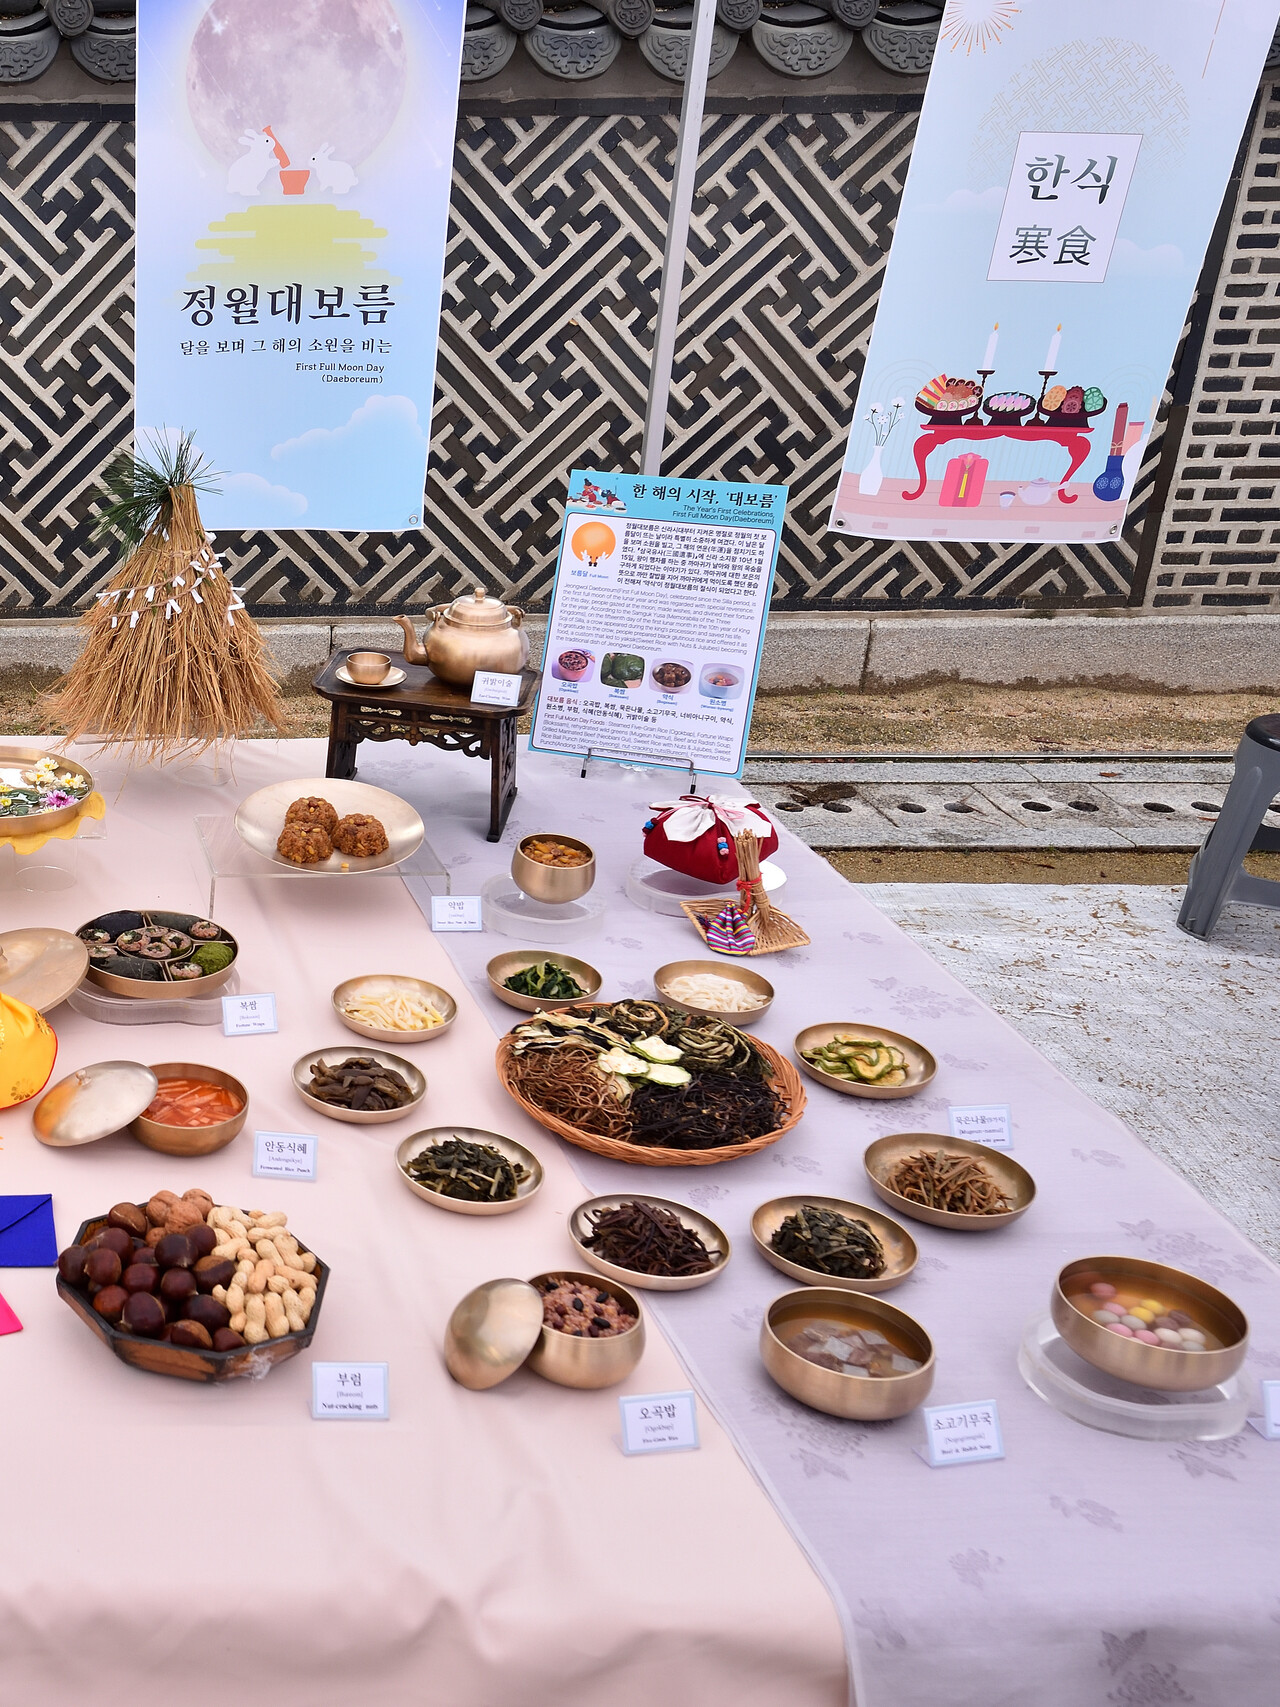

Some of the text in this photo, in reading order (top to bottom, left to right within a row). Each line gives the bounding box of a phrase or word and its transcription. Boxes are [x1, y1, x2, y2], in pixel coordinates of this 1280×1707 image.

[1025, 154, 1118, 204] 한식
[1009, 224, 1096, 266] 寒食
[181, 283, 395, 326] 정월대보름
[180, 338, 392, 356] 달을 보며 그 해의 소원을 비는
[296, 363, 384, 374] First Full Moon Day
[321, 375, 383, 384] (Daeboreum)
[633, 484, 647, 498] 한
[652, 486, 681, 502] 해의
[686, 488, 719, 504] 시작,
[719, 514, 774, 525] Day(Daeboreum)
[732, 508, 775, 519] Celebrations,
[448, 902, 464, 910] 약밥
[265, 1141, 307, 1154] 안동식혜
[337, 1372, 362, 1386] 부럼
[639, 1404, 676, 1419] 오곡밥
[933, 1412, 992, 1430] 소고기무국
